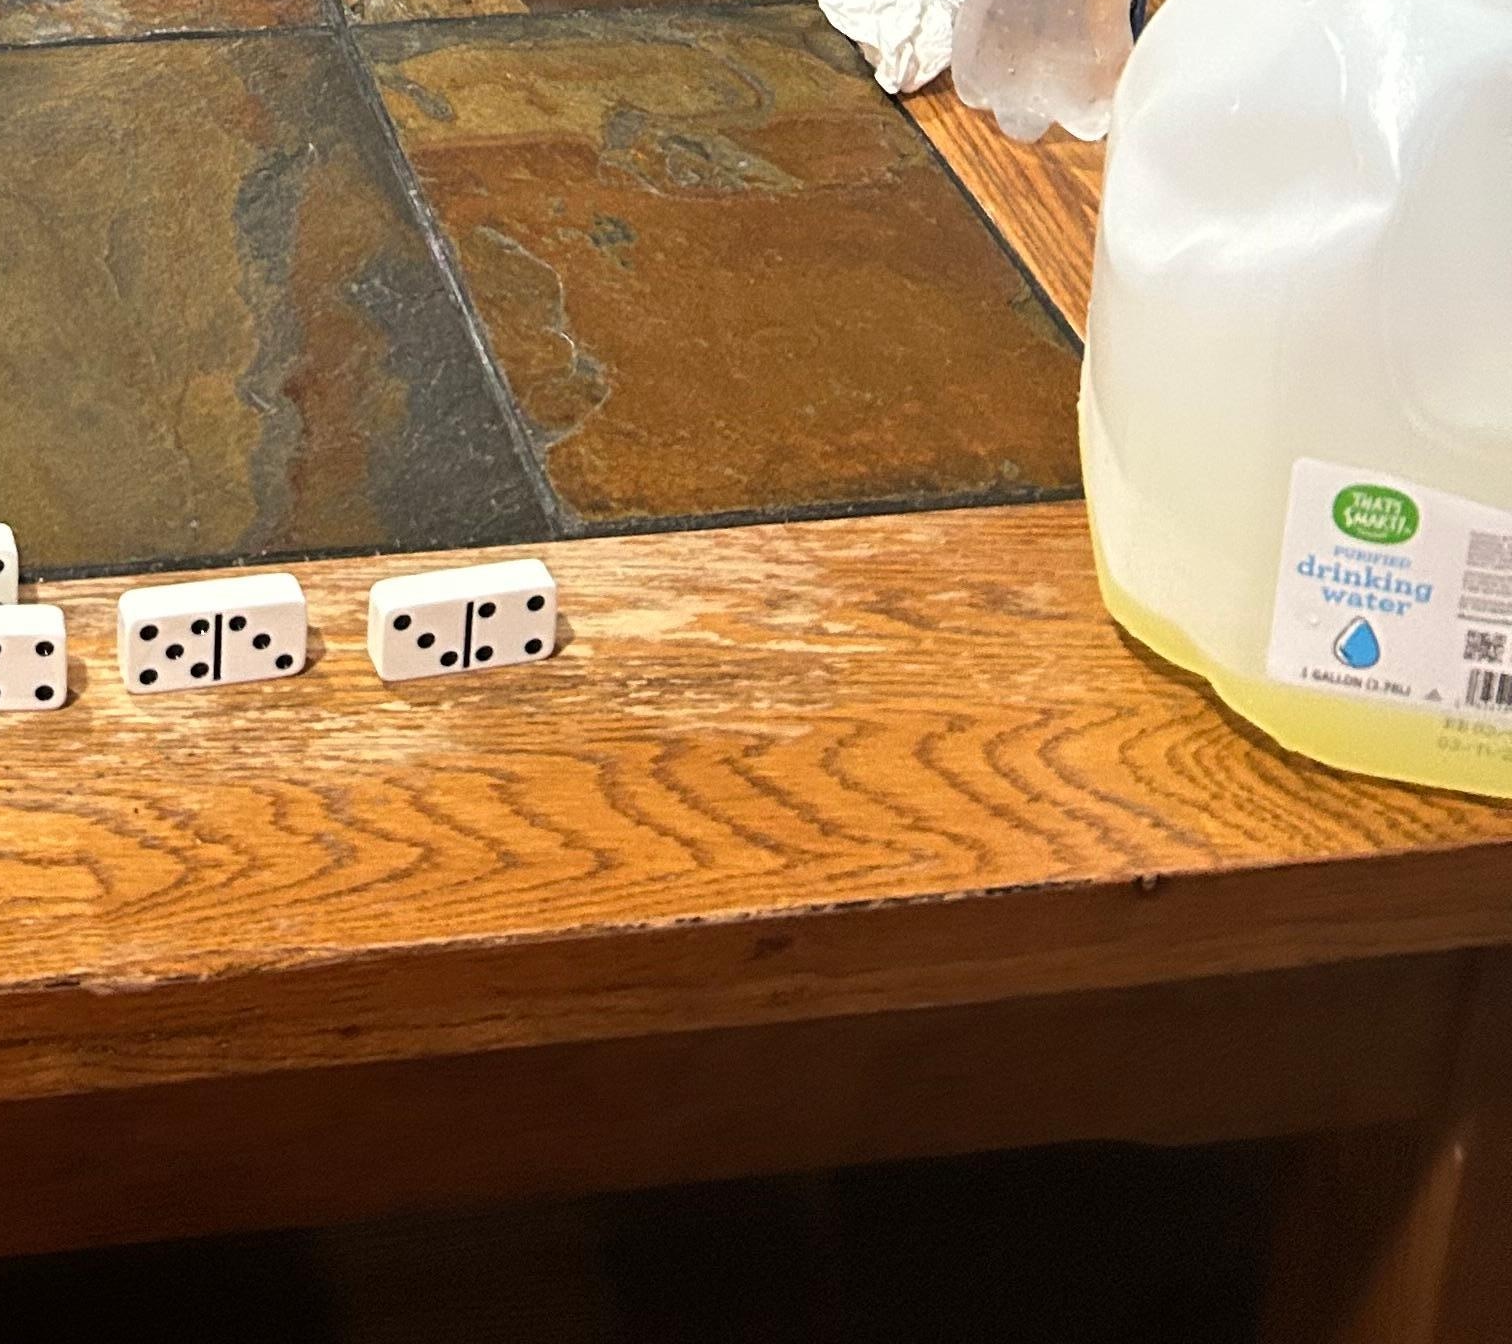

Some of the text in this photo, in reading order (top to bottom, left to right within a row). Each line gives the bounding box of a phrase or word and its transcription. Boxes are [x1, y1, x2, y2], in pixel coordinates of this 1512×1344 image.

[1333, 545, 1412, 568] PURIFIED
[1296, 554, 1433, 603] drinking
[1321, 586, 1413, 616] water
[1312, 669, 1363, 688] GALLON
